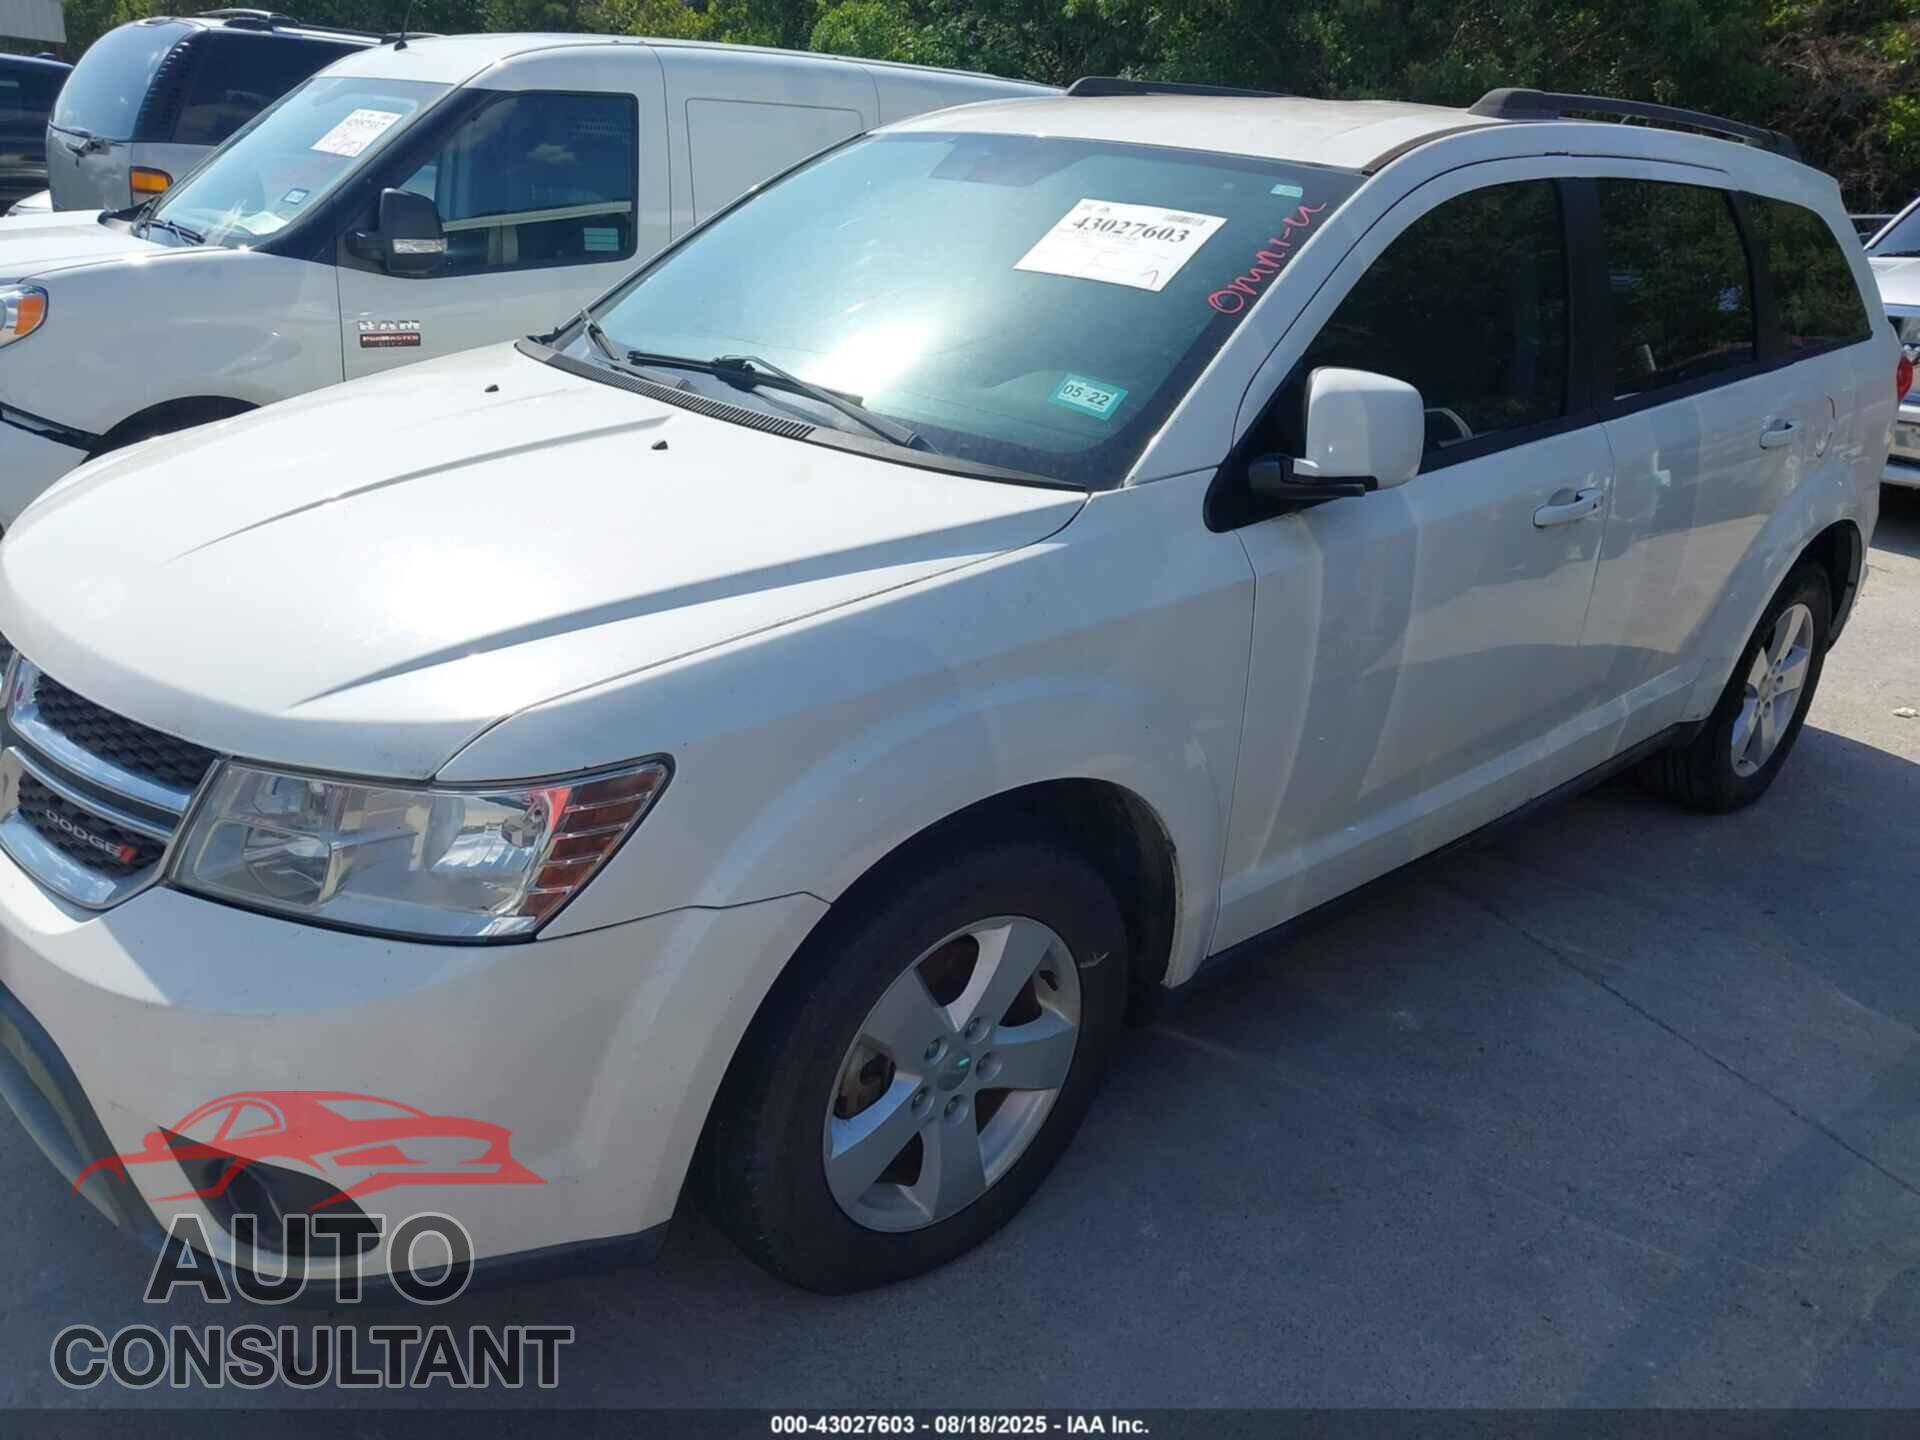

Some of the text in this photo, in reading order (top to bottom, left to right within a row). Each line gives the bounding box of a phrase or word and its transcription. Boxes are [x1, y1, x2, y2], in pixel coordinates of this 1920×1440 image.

[1072, 216, 1191, 243] 43027603
[1063, 384, 1110, 407] 05 22
[46, 808, 121, 858] DODGE
